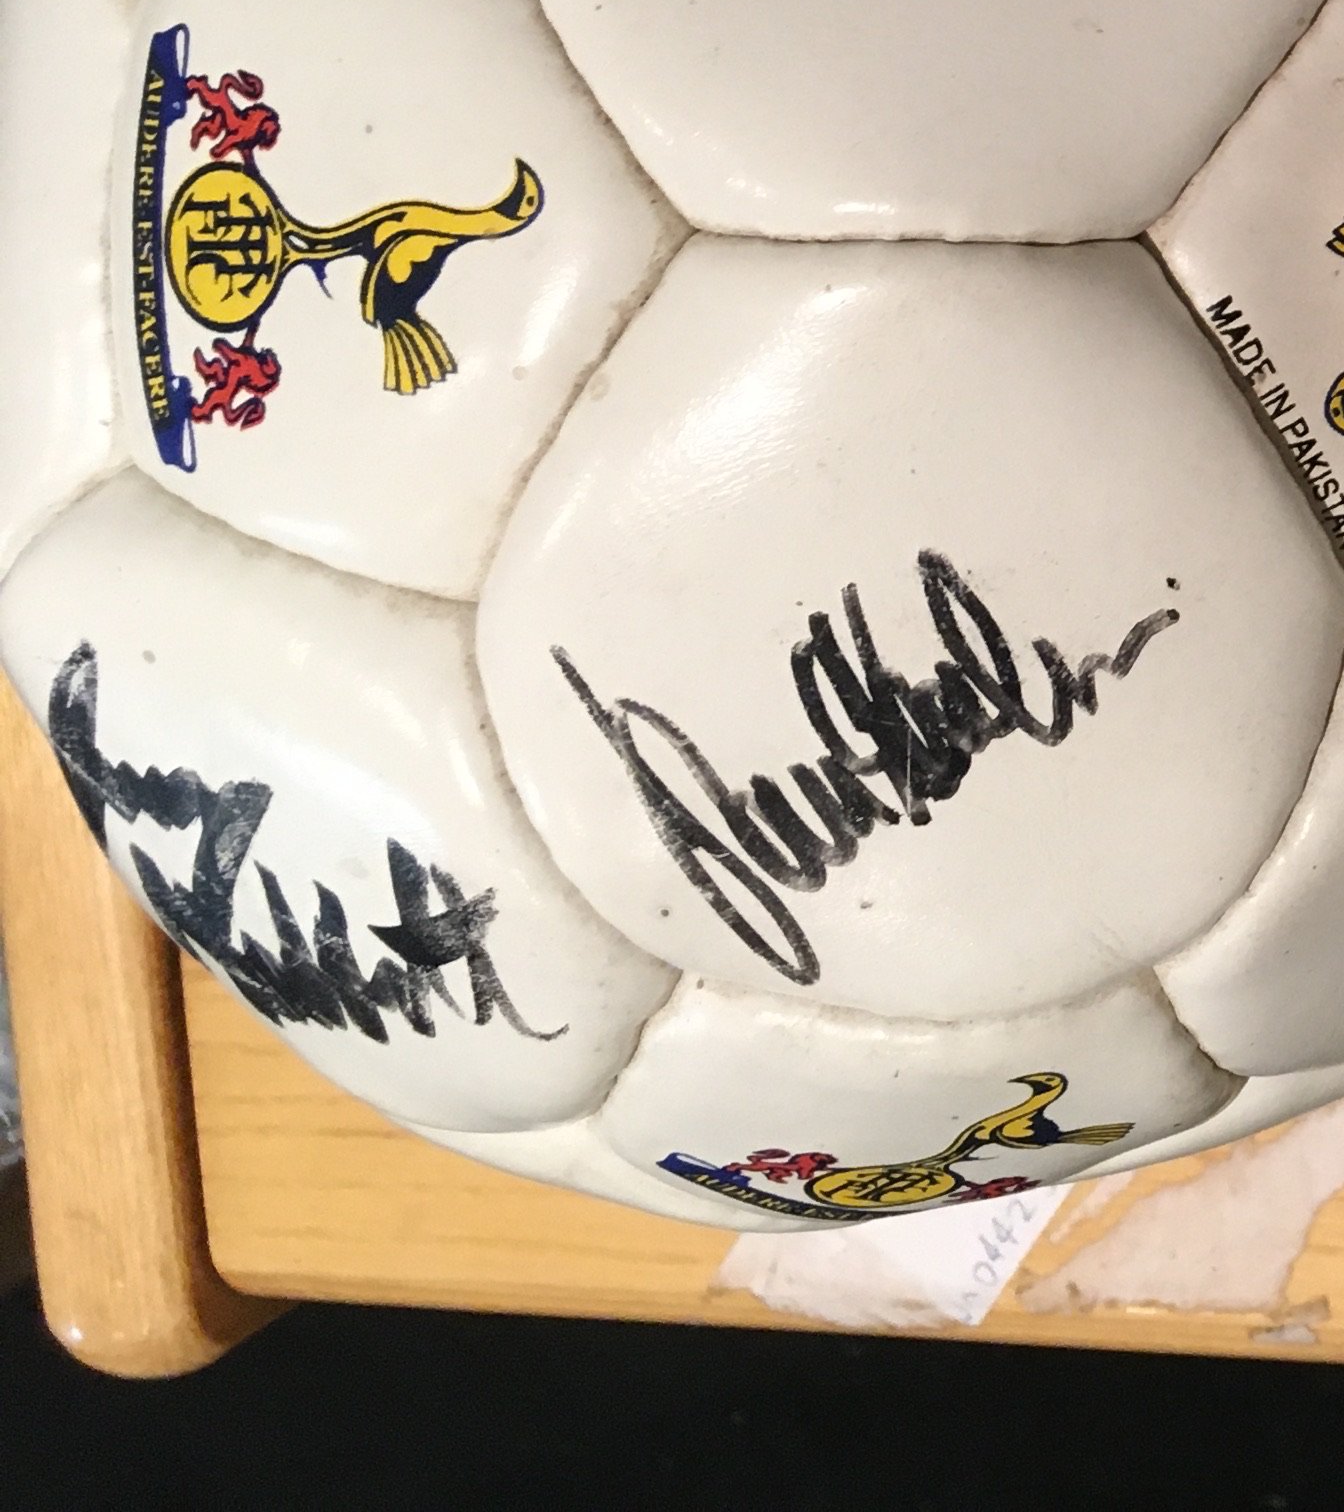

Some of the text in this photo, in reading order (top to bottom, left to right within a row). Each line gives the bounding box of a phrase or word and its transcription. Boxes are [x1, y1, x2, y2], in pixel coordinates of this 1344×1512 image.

[139, 291, 171, 421] FACERE
[1205, 294, 1277, 387] MADE
[1259, 382, 1296, 421] IN
